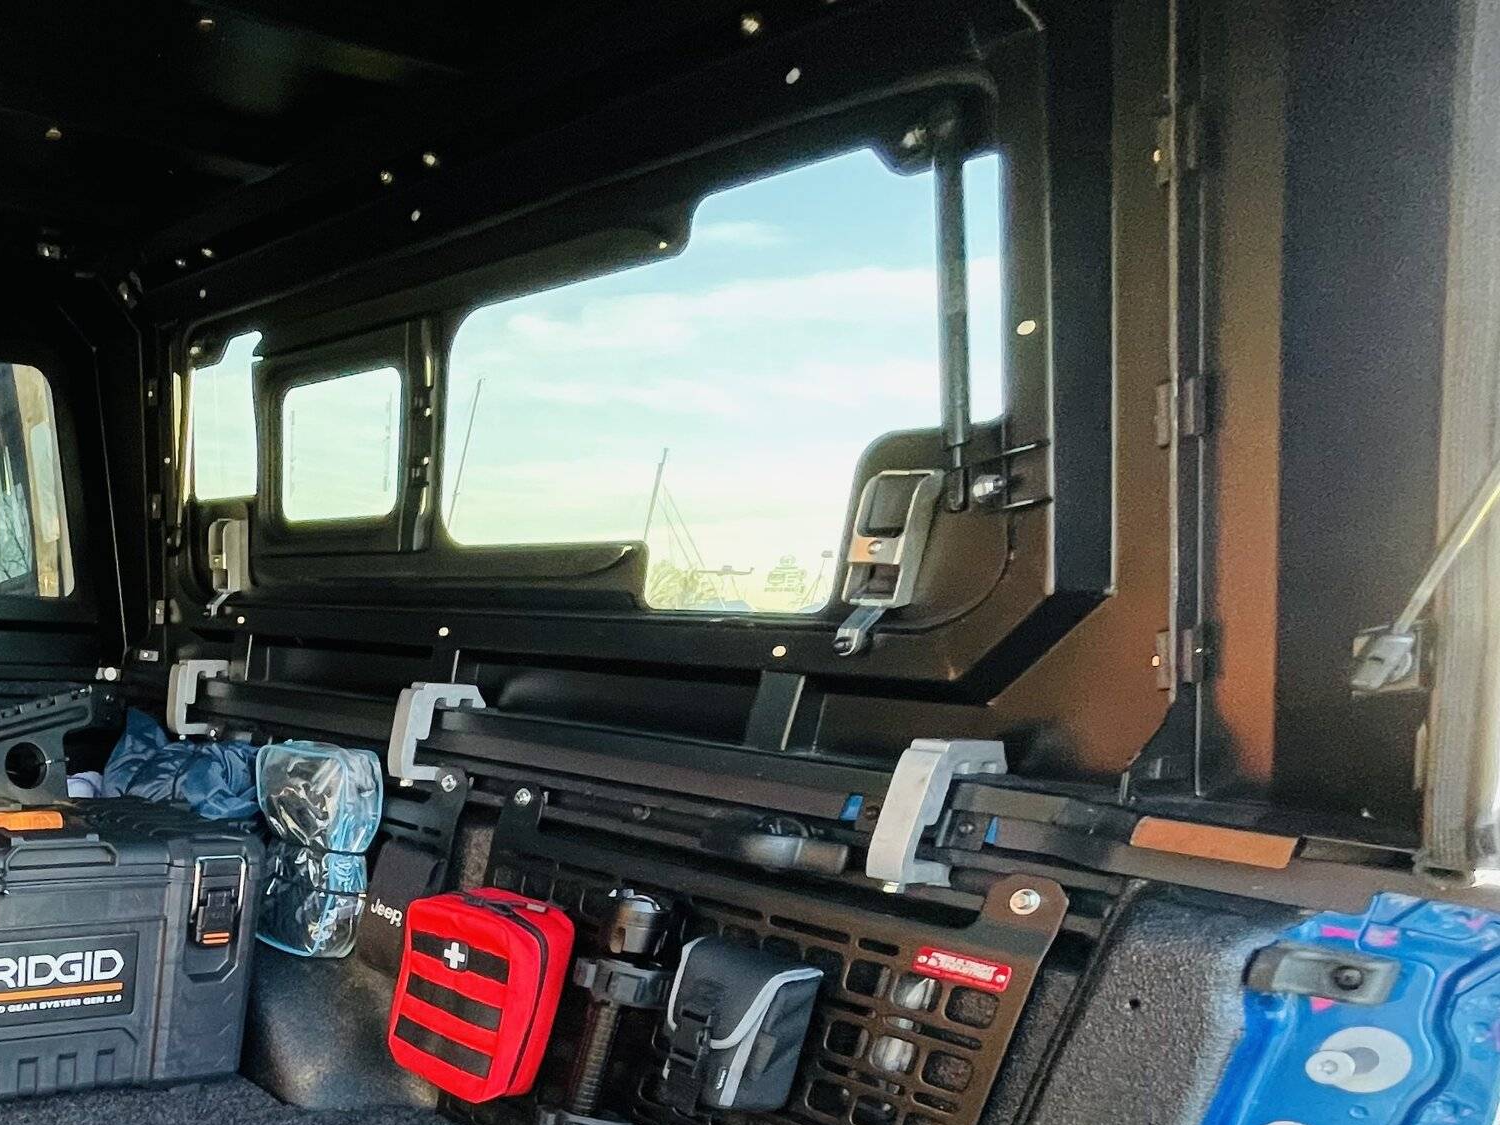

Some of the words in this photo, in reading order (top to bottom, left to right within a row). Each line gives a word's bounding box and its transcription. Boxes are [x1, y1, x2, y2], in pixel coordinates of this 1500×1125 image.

[370, 898, 403, 925] Jeep
[7, 1002, 37, 1013] GEAR
[39, 998, 82, 1010] SYSTEM
[83, 996, 105, 1006] GEN
[106, 994, 123, 1003] 2.0
